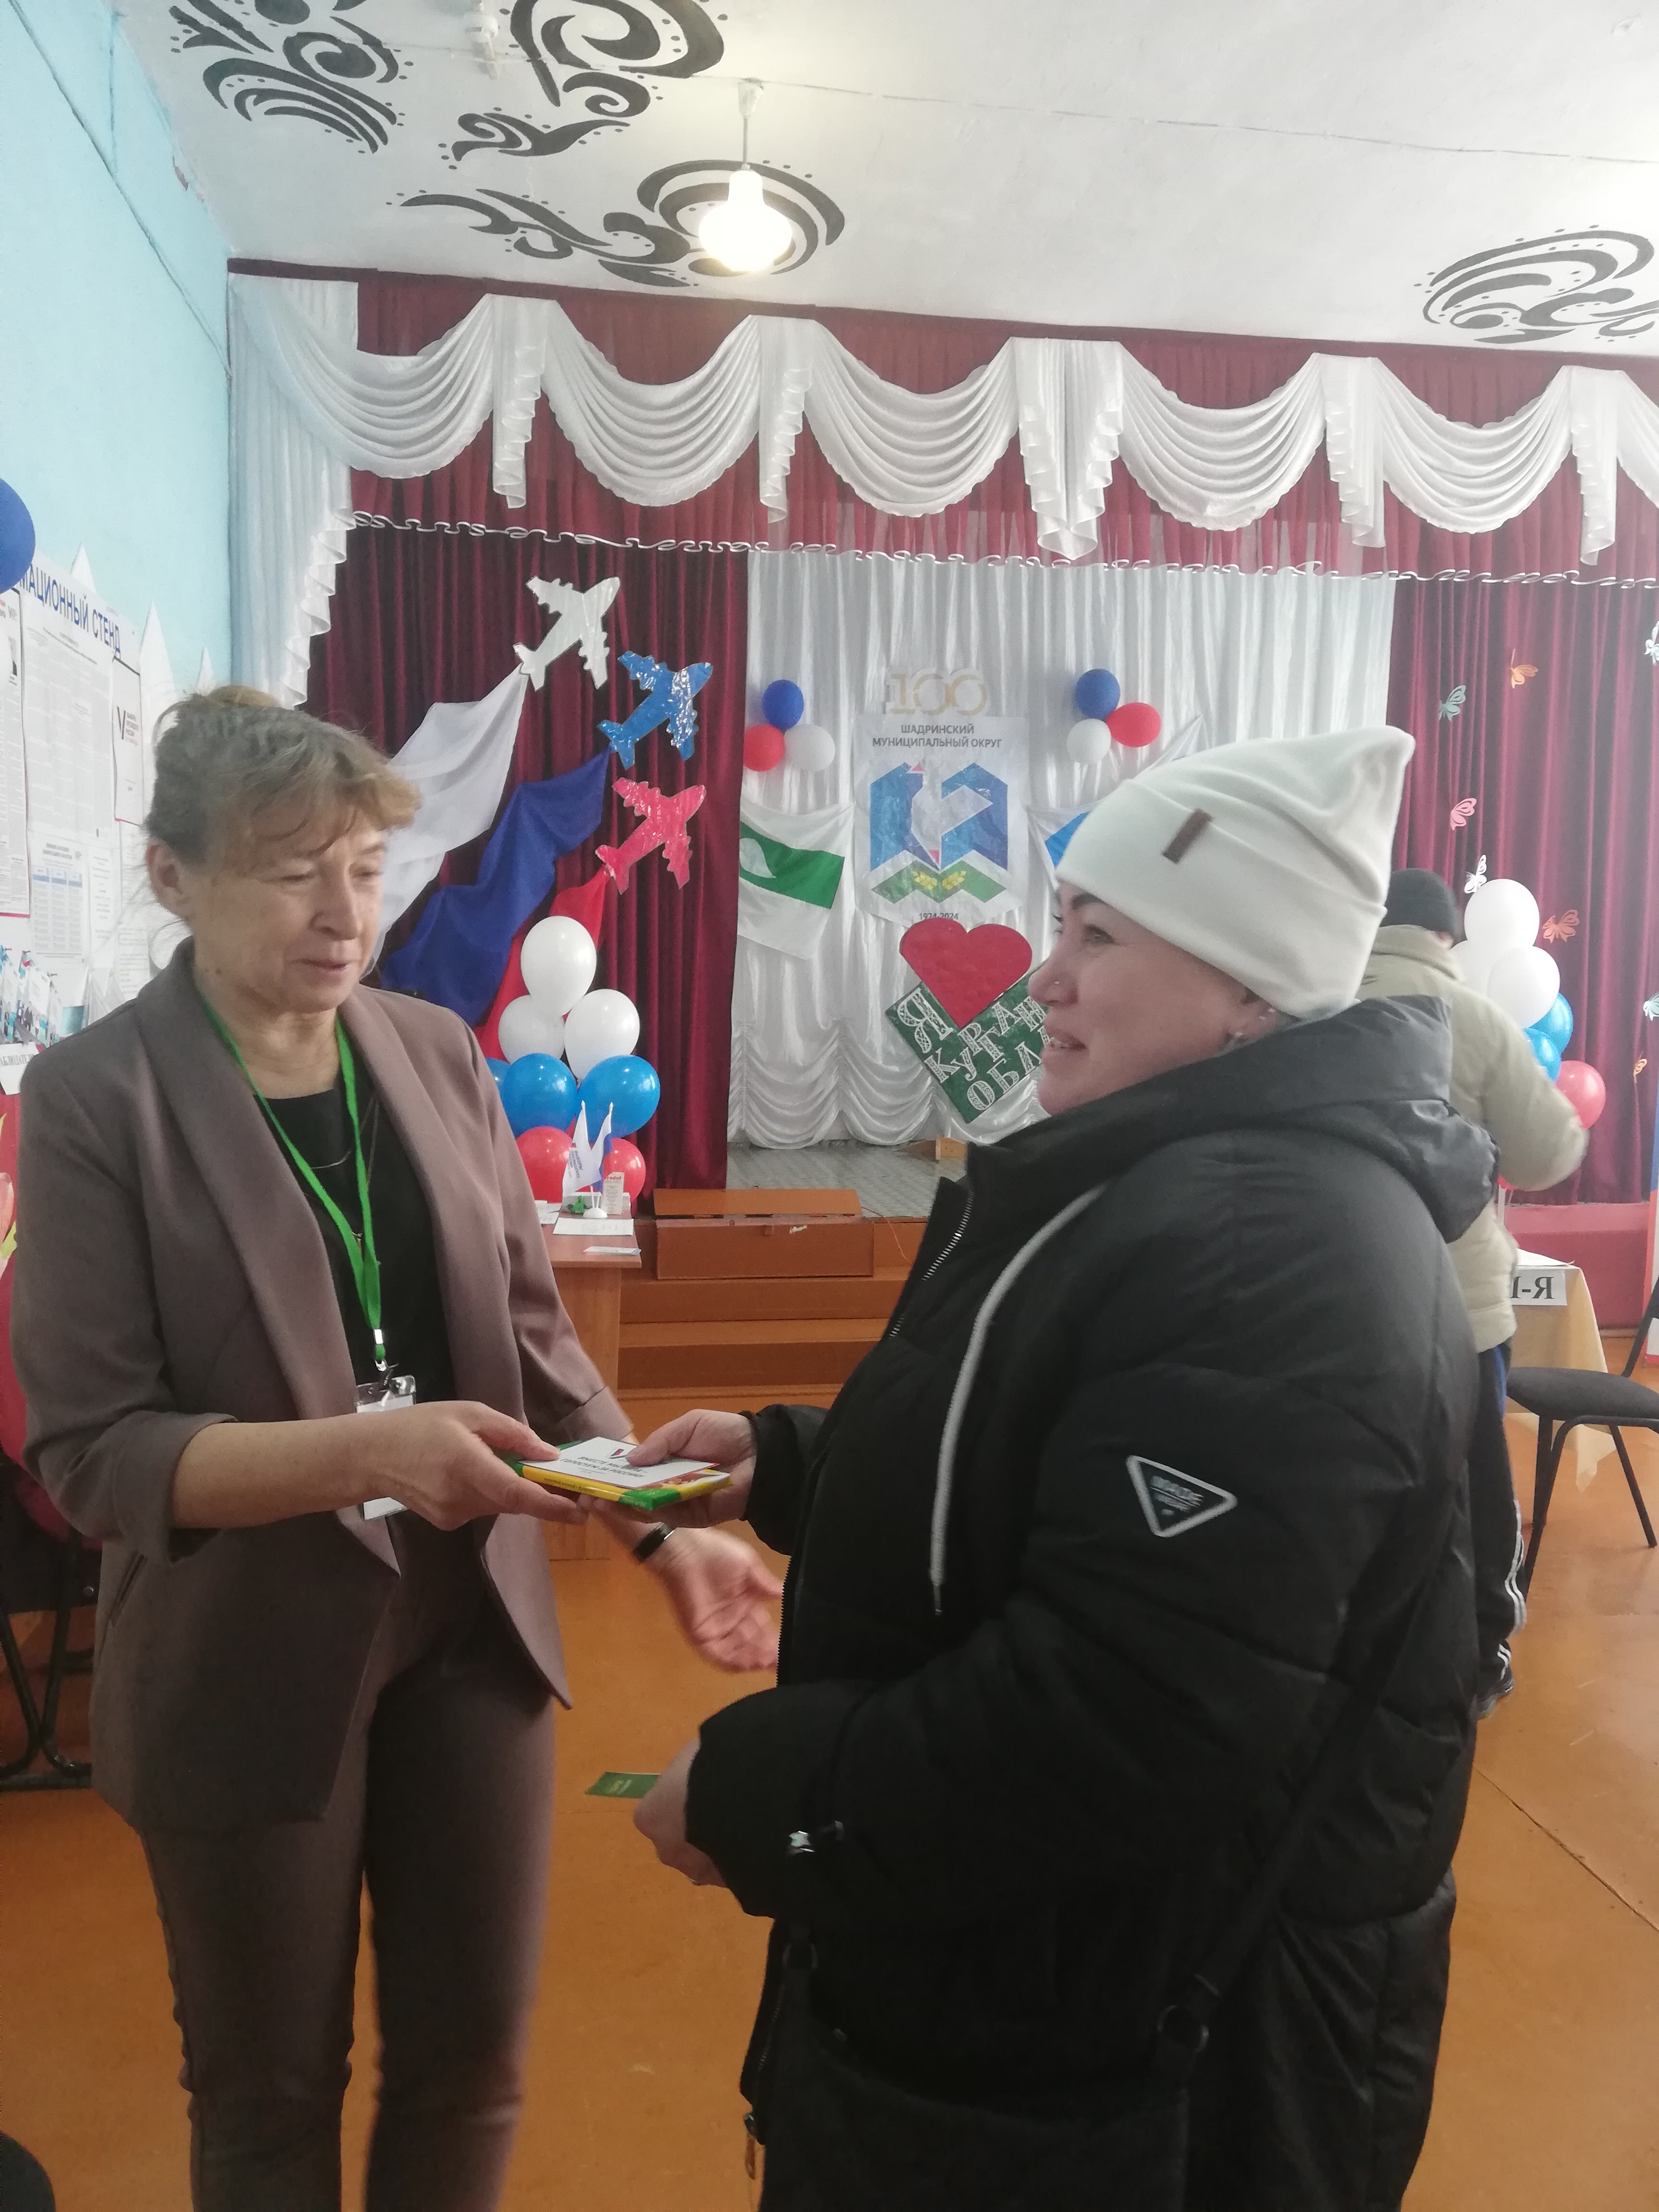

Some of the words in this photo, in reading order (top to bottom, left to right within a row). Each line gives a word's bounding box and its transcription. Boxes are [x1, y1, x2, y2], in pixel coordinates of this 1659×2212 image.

[93, 609, 121, 660] СТЕНД
[890, 673, 987, 716] 100
[873, 736, 968, 748] МУНИЦИПАЛЬНЫЙ
[971, 739, 1002, 748] ОКРУГ
[901, 723, 974, 735] ШАДРИНСКИЙ
[897, 987, 953, 1053] Я
